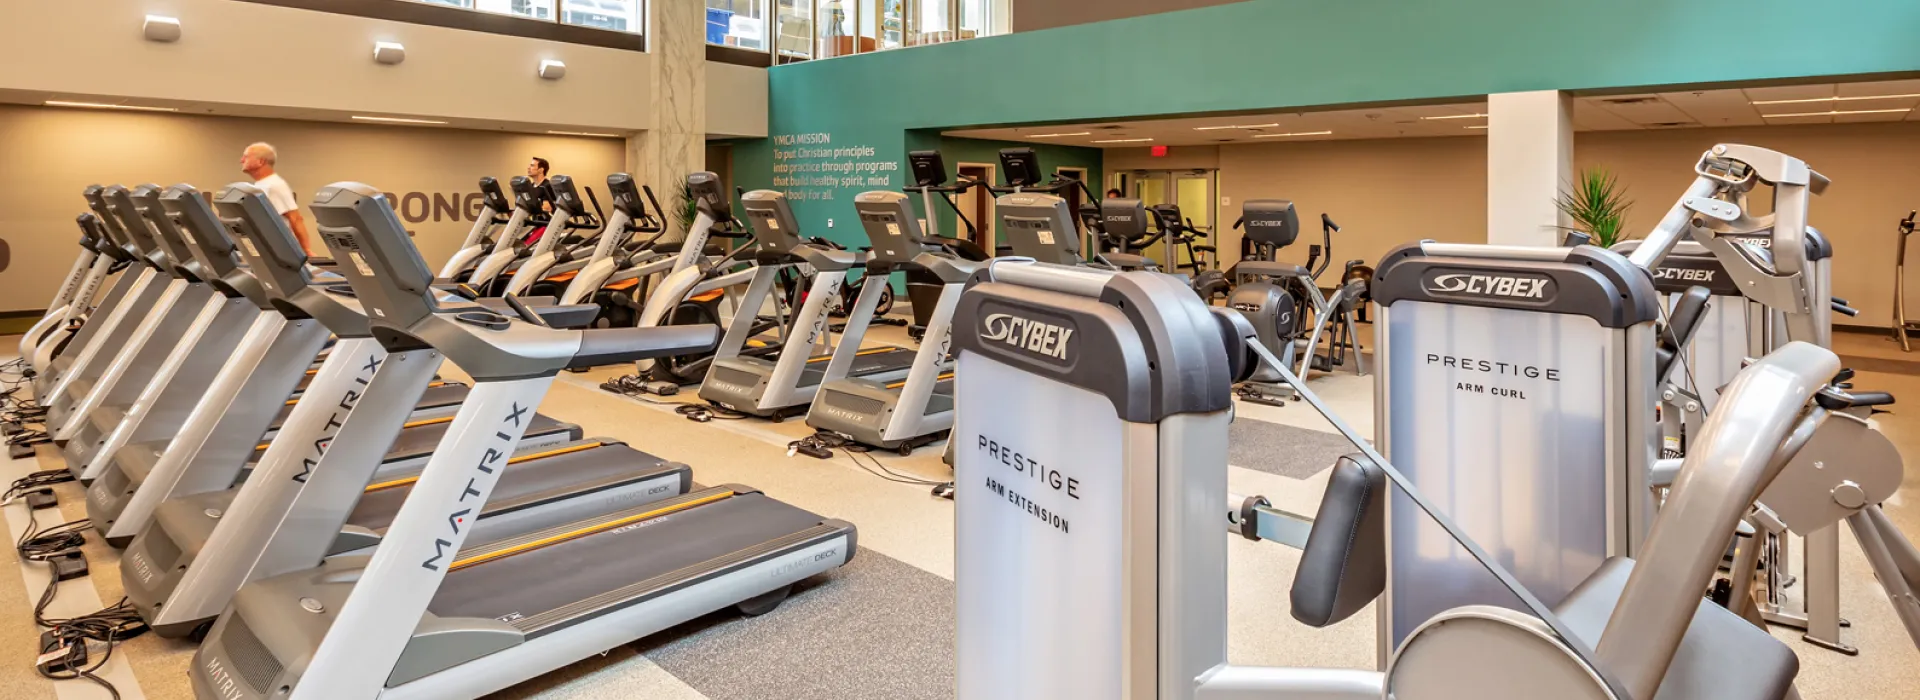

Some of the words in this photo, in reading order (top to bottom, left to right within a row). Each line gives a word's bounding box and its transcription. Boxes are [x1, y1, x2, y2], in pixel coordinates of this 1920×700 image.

[774, 134, 795, 145] YMCA
[797, 133, 830, 144] MISSION
[774, 149, 783, 159] To
[784, 149, 797, 161] put
[798, 147, 832, 158] Christian
[834, 145, 875, 160] principles
[774, 163, 788, 173] into
[789, 163, 820, 175] practice
[822, 161, 854, 174] through
[856, 161, 898, 174] programs
[774, 176, 789, 187] that
[790, 176, 808, 187] build
[810, 176, 839, 188] healthy
[841, 175, 867, 188] spirit,
[868, 175, 890, 186] mind
[788, 189, 806, 202] body
[808, 190, 820, 200] for
[822, 189, 834, 200] all.
[688, 231, 707, 264] MATRIX
[1664, 267, 1716, 282] CYBEX
[1465, 274, 1549, 298] CYBEX
[807, 279, 840, 345] MATRIX
[1006, 316, 1074, 361] CYBEX
[1427, 353, 1560, 382] PRESTIGE
[715, 382, 743, 393] MATRIX
[1456, 382, 1484, 394] ARM
[1491, 387, 1526, 400] CURL
[292, 354, 383, 483] MATRIX
[827, 407, 864, 423] MATRIX
[978, 434, 1080, 500] PRESTIGE
[422, 401, 528, 571] MATRIX
[648, 484, 670, 495] DECK
[985, 476, 1005, 498] ARM
[1008, 489, 1069, 534] EXTENSION
[814, 547, 837, 562] DECK
[132, 551, 153, 585] MATRIX
[206, 656, 244, 700] MATRIX
